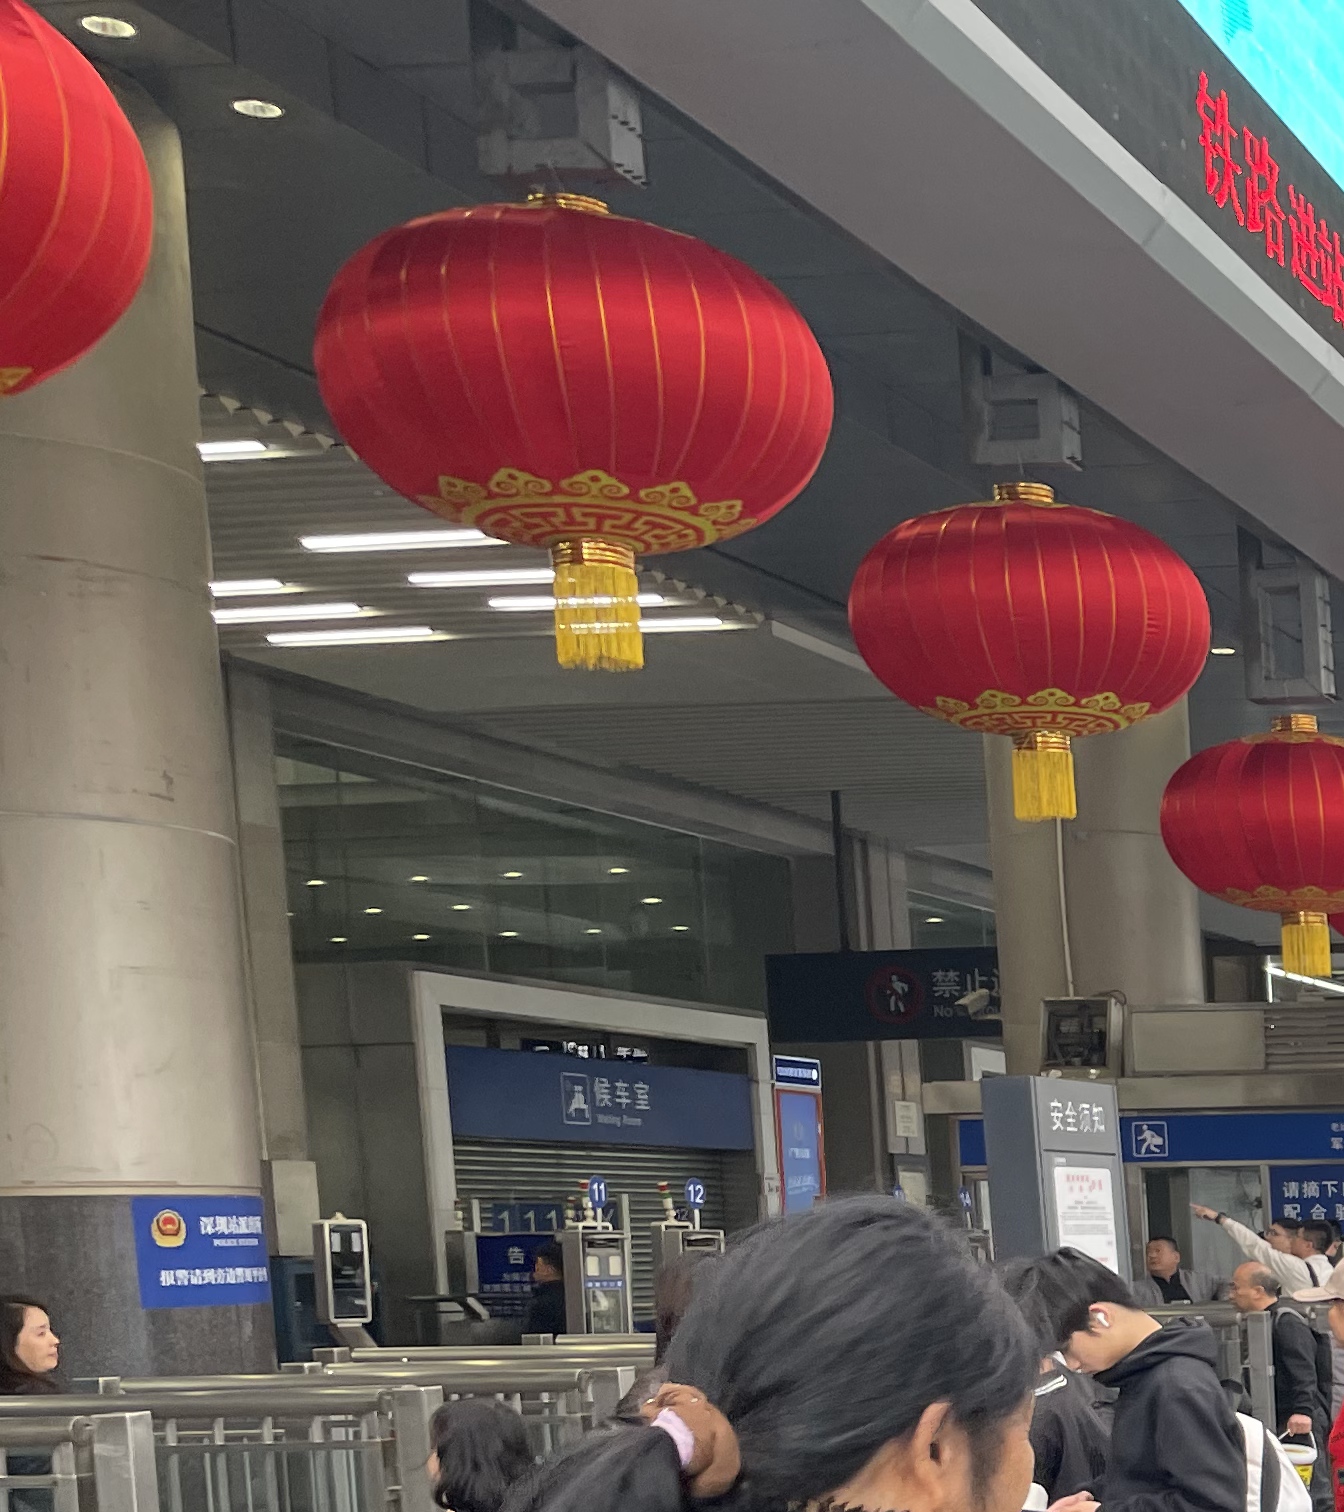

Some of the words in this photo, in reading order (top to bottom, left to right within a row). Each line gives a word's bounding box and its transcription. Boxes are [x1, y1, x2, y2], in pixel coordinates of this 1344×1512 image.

[931, 967, 1000, 998] 禁止
[594, 1077, 650, 1109] 候车室
[1050, 1099, 1105, 1132] 安全须知
[592, 1182, 605, 1202] 11
[688, 1184, 704, 1203] 12
